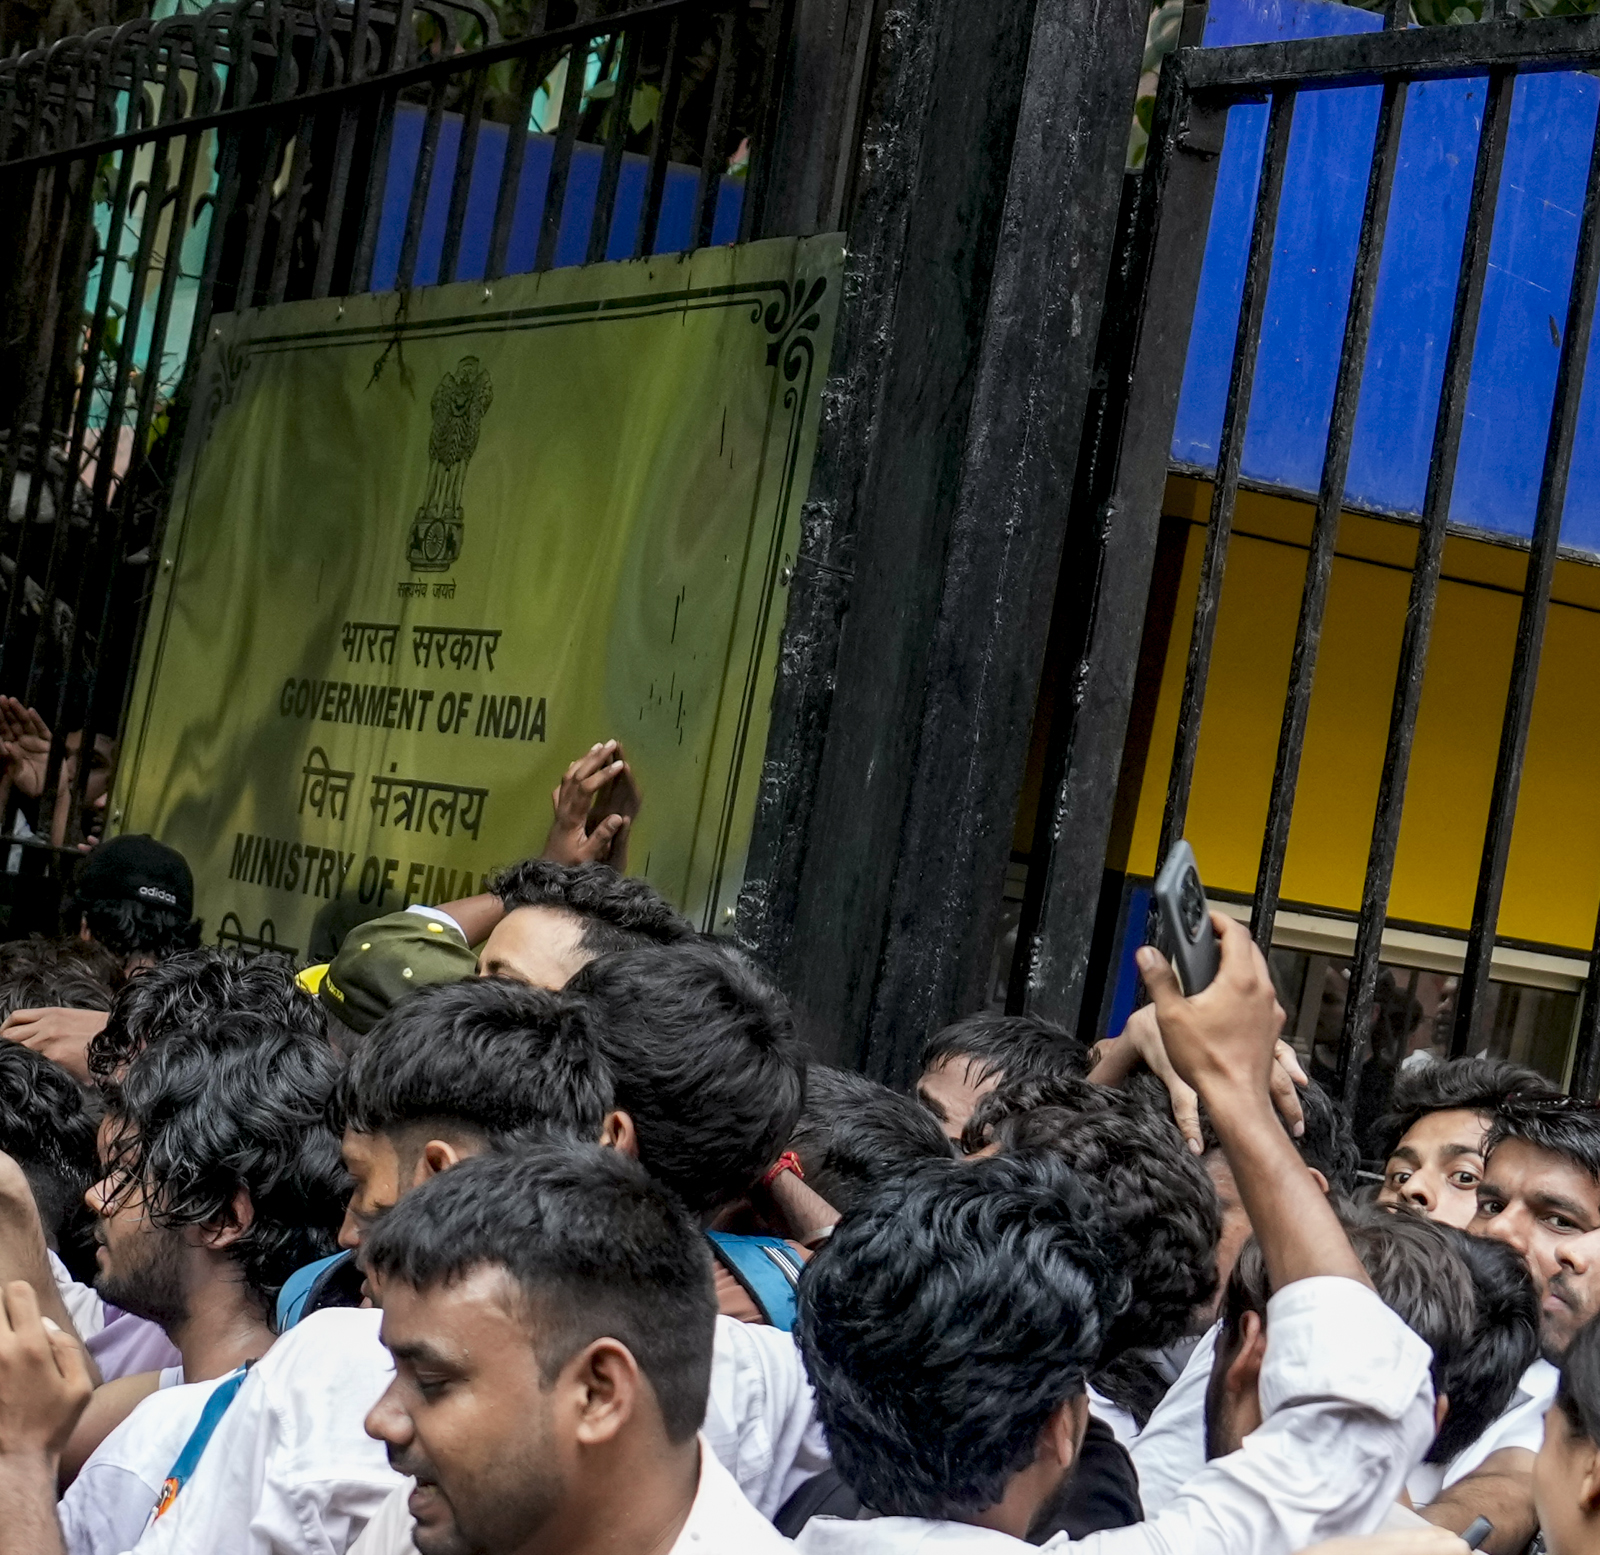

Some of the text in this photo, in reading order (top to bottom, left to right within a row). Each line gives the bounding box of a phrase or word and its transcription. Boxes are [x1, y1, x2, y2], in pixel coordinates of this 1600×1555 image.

[342, 621, 502, 672] भारत सरकार
[279, 677, 547, 743] GOVERNMENT OF INDIA
[299, 746, 490, 841] वित्त मंत्रालय
[138, 886, 177, 905] adidas
[228, 833, 356, 900] MINISTRY
[358, 856, 400, 908] OF
